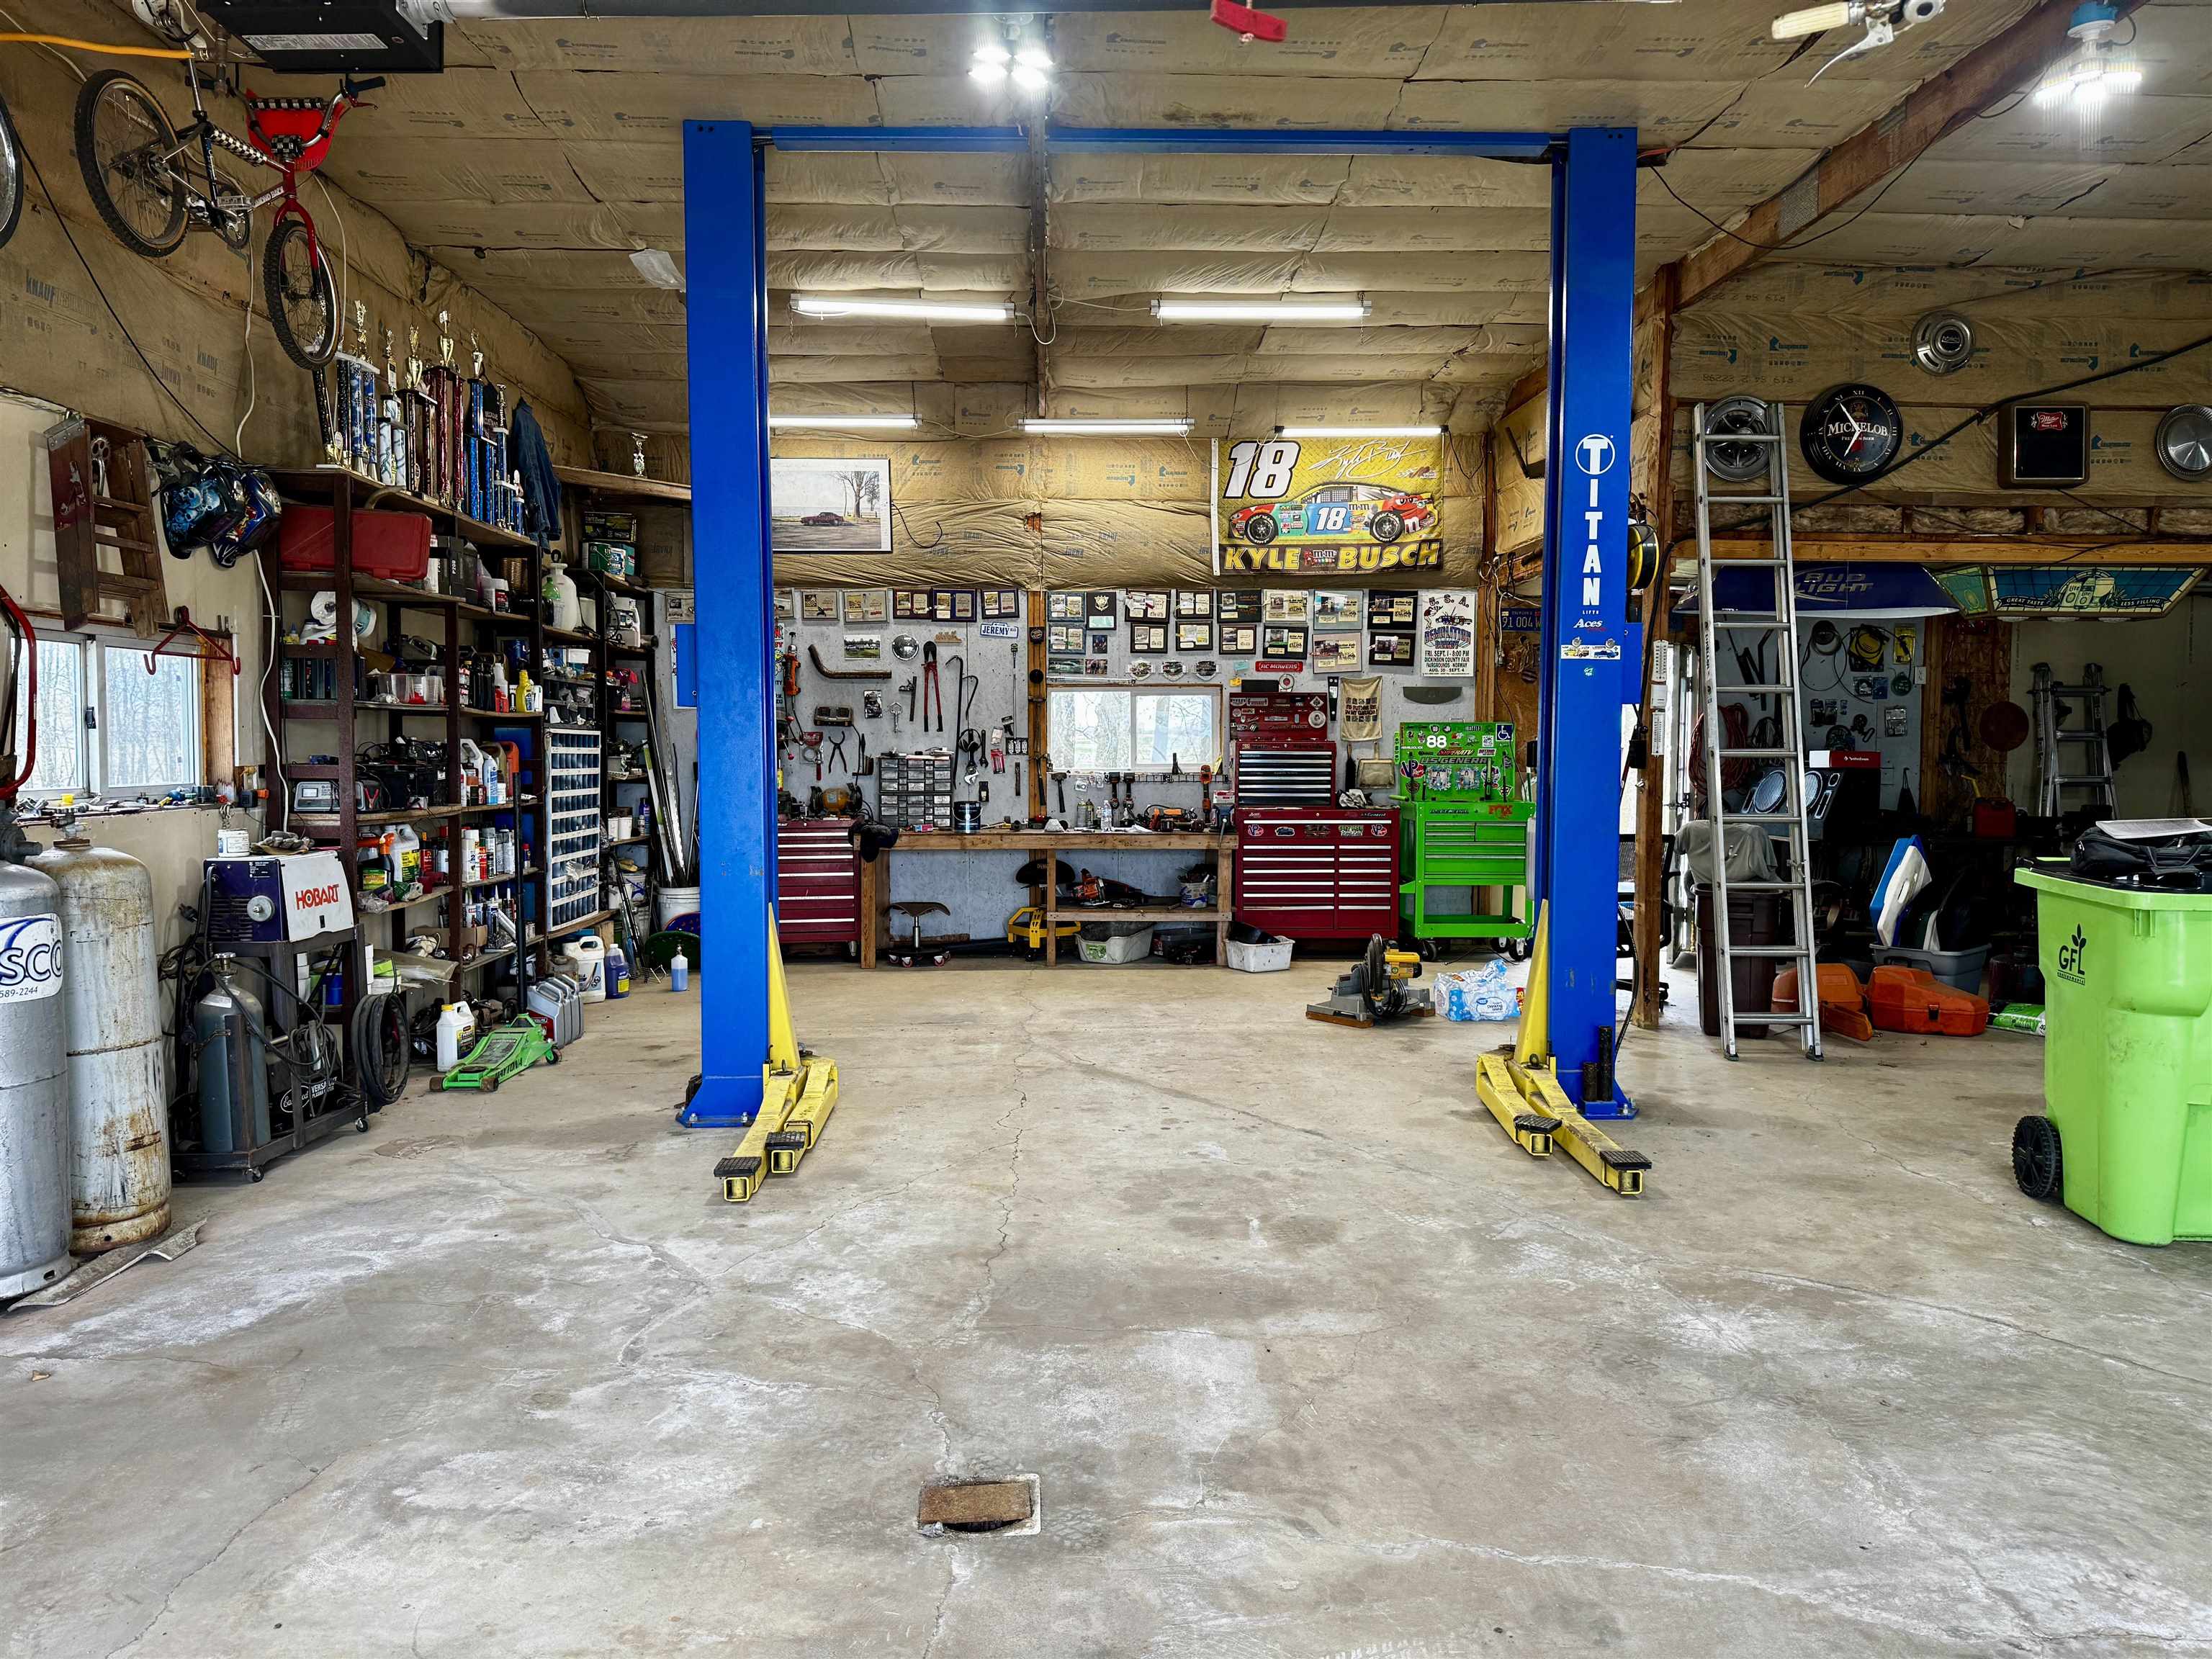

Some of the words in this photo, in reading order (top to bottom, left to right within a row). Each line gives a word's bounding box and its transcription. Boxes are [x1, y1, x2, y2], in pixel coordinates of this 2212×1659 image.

[1223, 440, 1302, 499] 18
[1316, 505, 1349, 531] 18
[1579, 436, 1612, 606] TITAN
[1224, 547, 1301, 570] KYLE
[1337, 542, 1441, 570] BUSCH
[1804, 572, 1866, 583] BUD
[1794, 583, 1874, 593] LIGHT
[982, 626, 1009, 636] JEREMY
[1502, 617, 1513, 628] 91
[1573, 618, 1604, 629] Aces
[1426, 735, 1447, 748] 88
[1401, 760, 1419, 778] VP
[295, 884, 340, 910] HOBART
[2059, 945, 2085, 976] GFL
